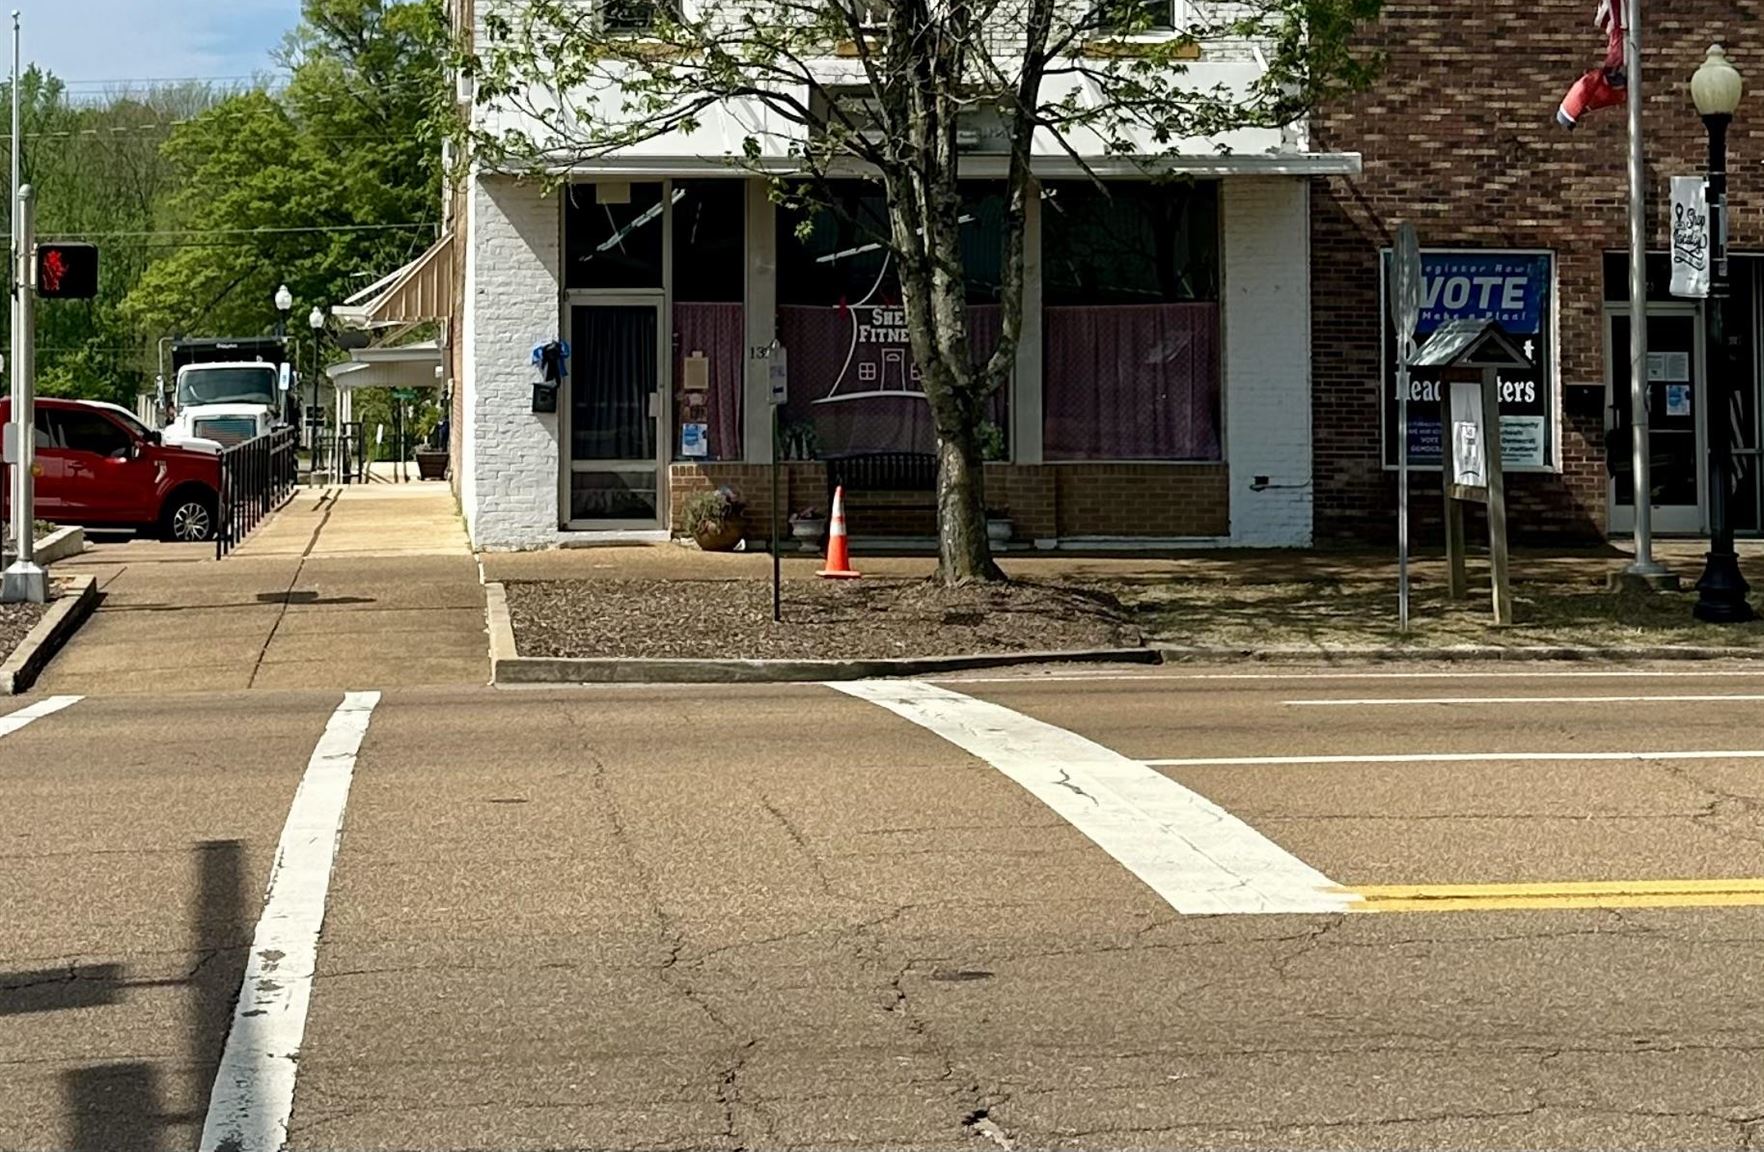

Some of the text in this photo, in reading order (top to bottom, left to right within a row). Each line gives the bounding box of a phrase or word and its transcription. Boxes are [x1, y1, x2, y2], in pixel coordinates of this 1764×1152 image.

[1686, 208, 1706, 232] Shop
[1425, 262, 1486, 275] egister
[1420, 276, 1528, 309] VOTE
[872, 308, 908, 326] SHE
[859, 324, 910, 343] FITNE
